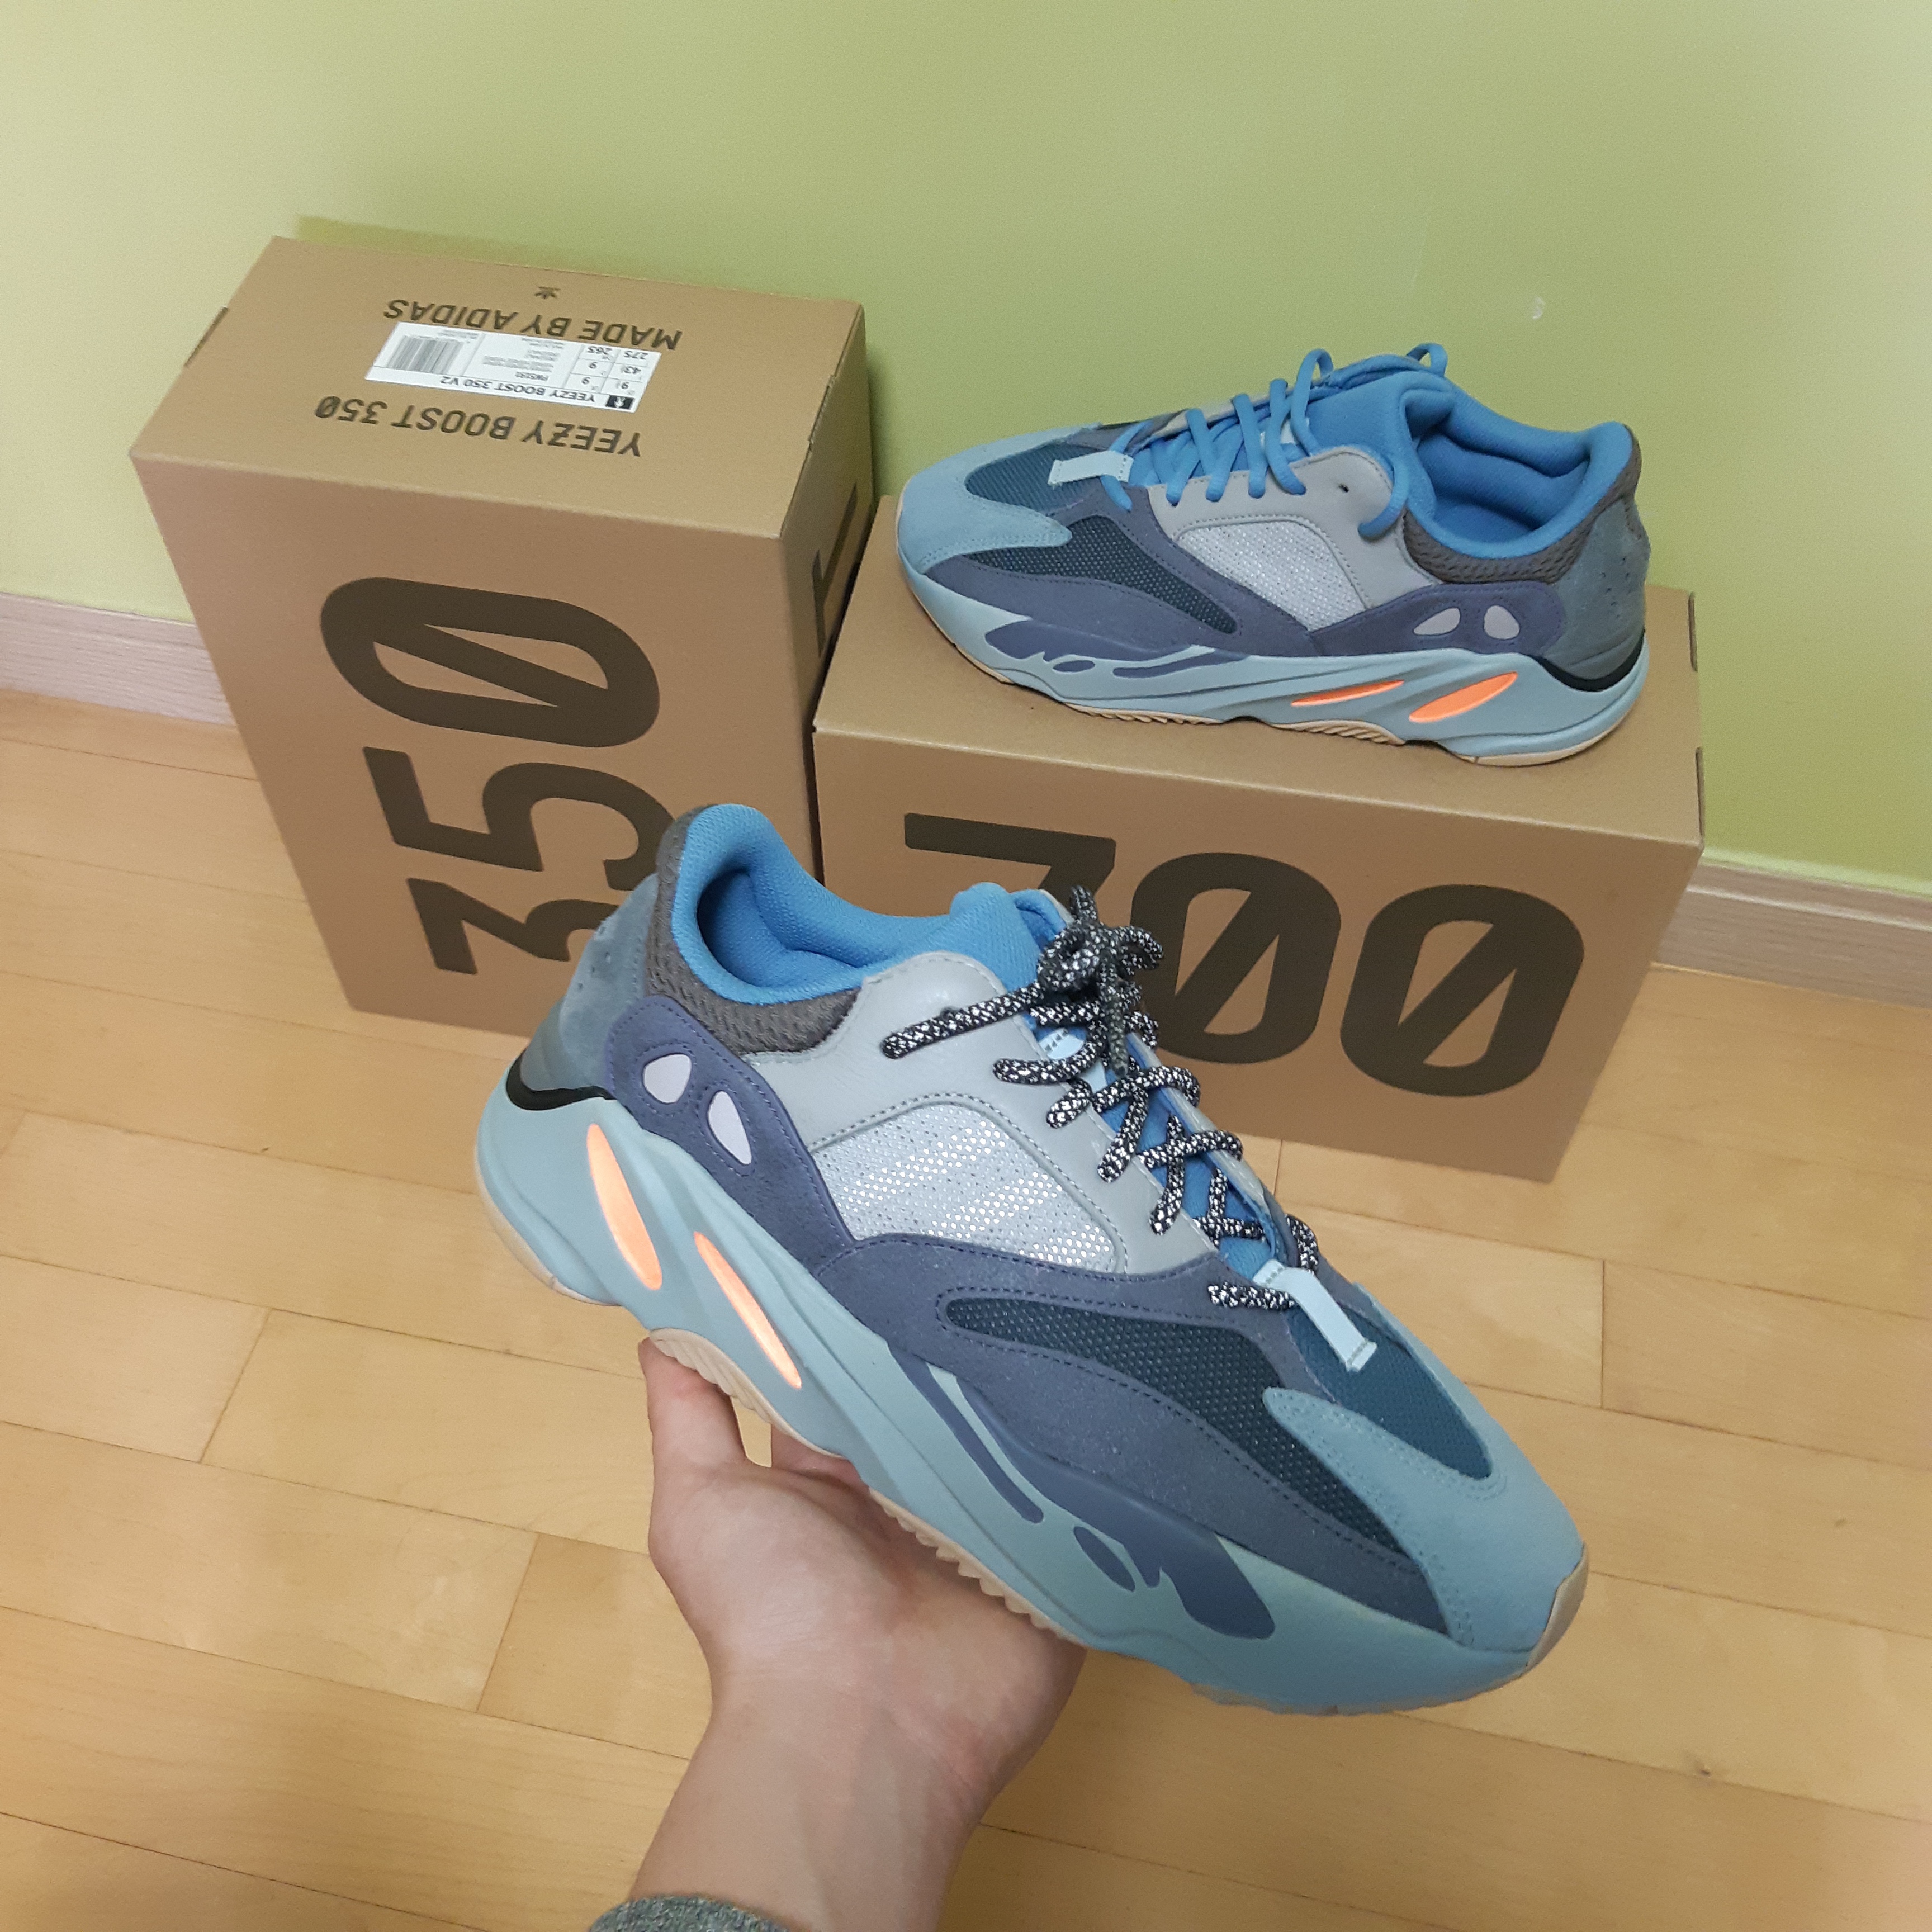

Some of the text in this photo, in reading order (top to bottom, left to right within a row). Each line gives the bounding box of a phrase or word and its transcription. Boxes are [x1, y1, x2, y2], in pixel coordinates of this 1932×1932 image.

[383, 299, 519, 329] ADIDAS
[520, 314, 572, 337] BY
[577, 319, 683, 351] MADE
[441, 376, 595, 402] YEEZY BOOST 350 V2
[315, 396, 641, 457] YEEZY BOOST 350
